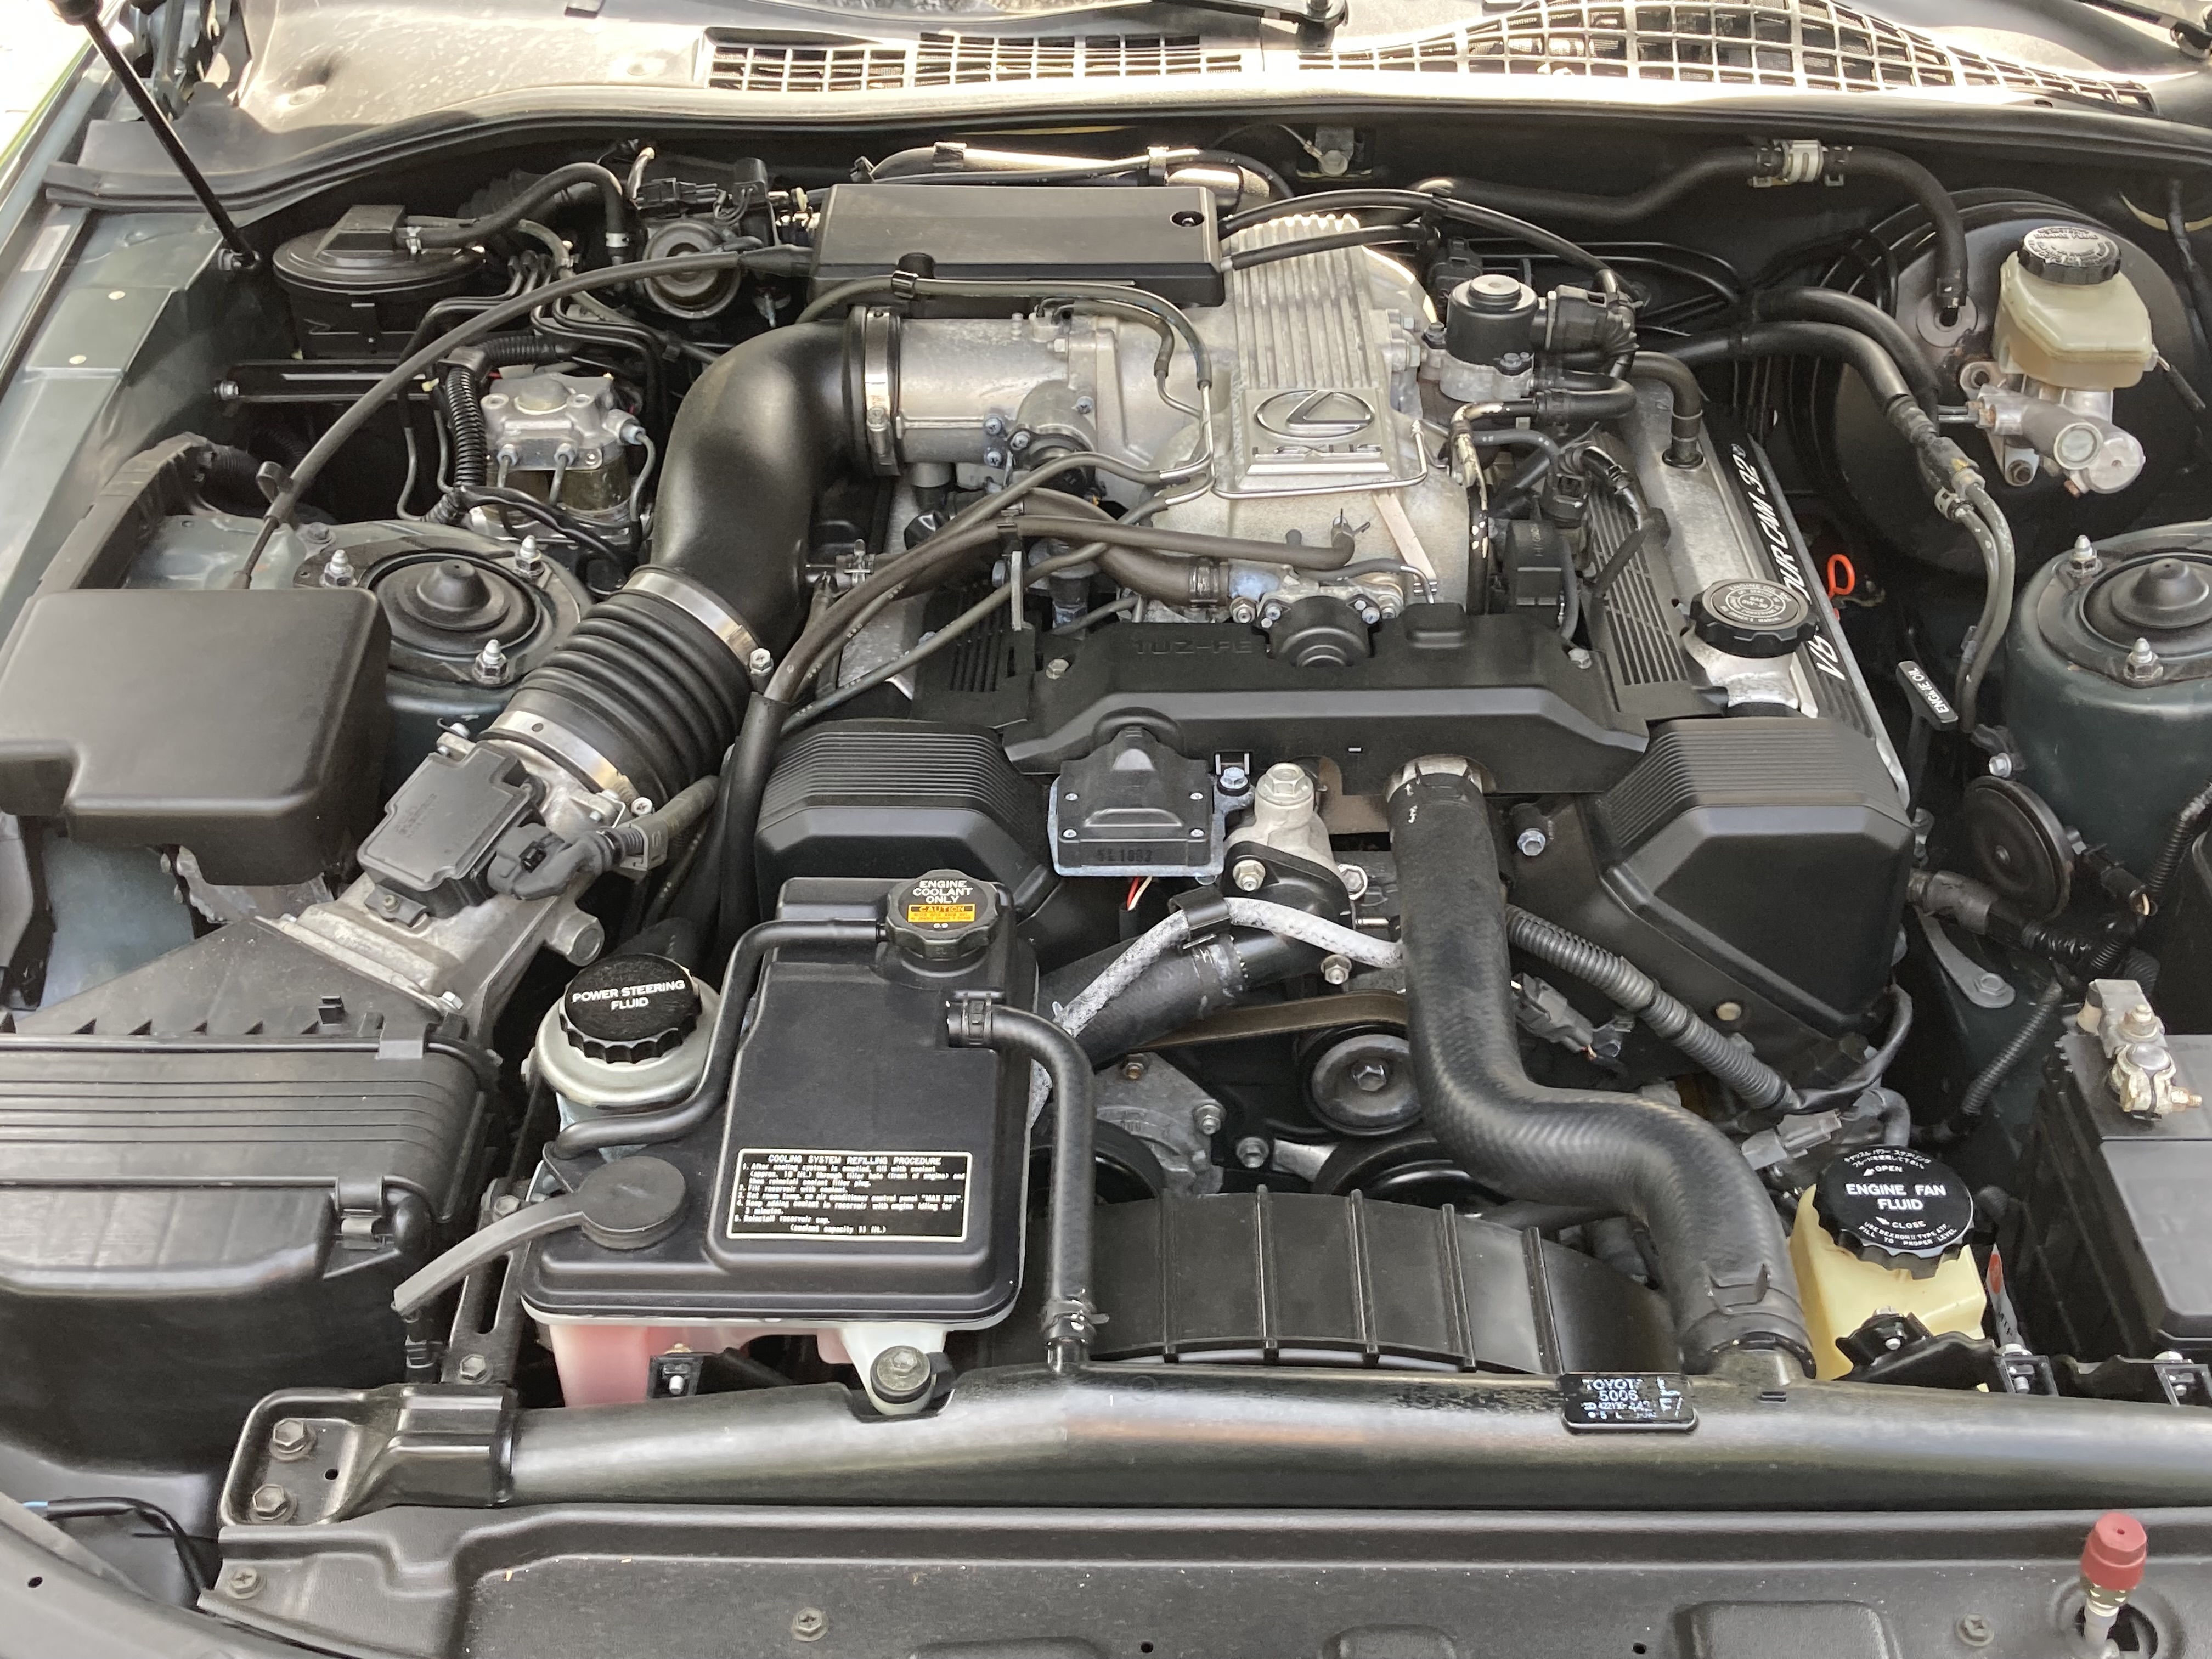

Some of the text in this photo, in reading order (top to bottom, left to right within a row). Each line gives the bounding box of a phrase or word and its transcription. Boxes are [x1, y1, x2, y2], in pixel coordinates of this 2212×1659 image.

[1252, 444, 1384, 459] LEXUS
[1732, 454, 1766, 495] 32
[1748, 492, 1789, 549] CAM
[1908, 667, 1925, 681] OIL
[919, 880, 968, 888] ENGINE
[912, 888, 973, 896] COOLANT
[926, 895, 960, 904] ONLY
[572, 980, 685, 1003] POWER STEERING
[611, 997, 649, 1011] FLUID
[768, 1154, 942, 1165] COOLING SYSTEM REFILLING PROCEDURE
[1845, 1184, 1947, 1196] ENGINE FAN
[1877, 1198, 1924, 1210] FLUID
[1864, 1222, 1878, 1232] USE
[1917, 1230, 1937, 1240] TYPE
[1936, 1223, 1948, 1235] ATF
[1892, 1220, 1927, 1229] CLOSE
[1858, 1226, 1876, 1238] FILL
[1937, 1228, 1958, 1242] LEVEL
